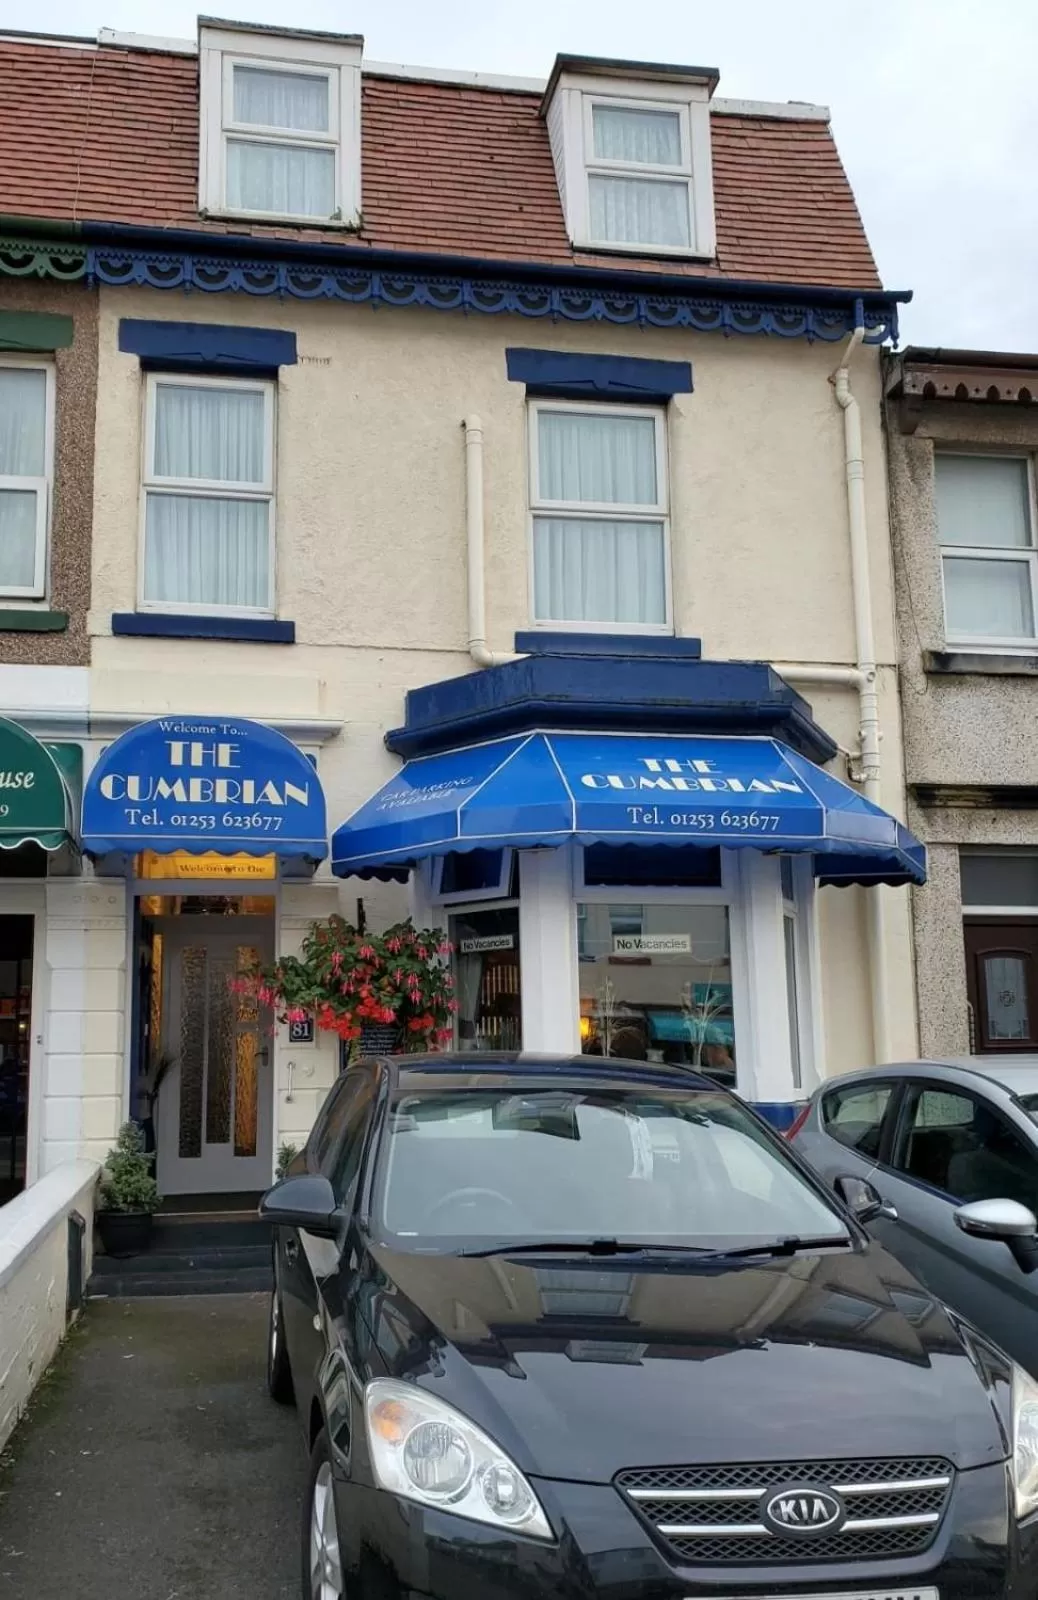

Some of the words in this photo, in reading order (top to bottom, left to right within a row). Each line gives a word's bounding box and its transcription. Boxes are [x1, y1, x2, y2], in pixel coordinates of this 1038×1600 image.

[158, 721, 216, 735] Welcome
[164, 740, 241, 768] THE
[637, 758, 722, 774] THE
[100, 774, 309, 807] CUMBRIAN
[581, 774, 804, 794] CUMBRIAN
[125, 809, 163, 827] Tel.
[170, 813, 215, 829] 01253
[222, 812, 283, 831] 623677
[627, 807, 664, 825] Tel.
[670, 812, 714, 828] 01253
[720, 811, 780, 831] 623677
[463, 942, 474, 950] No
[616, 939, 633, 950] No
[634, 938, 687, 949] Vacancies
[292, 1022, 309, 1037] 81
[778, 1499, 830, 1521] KIA
